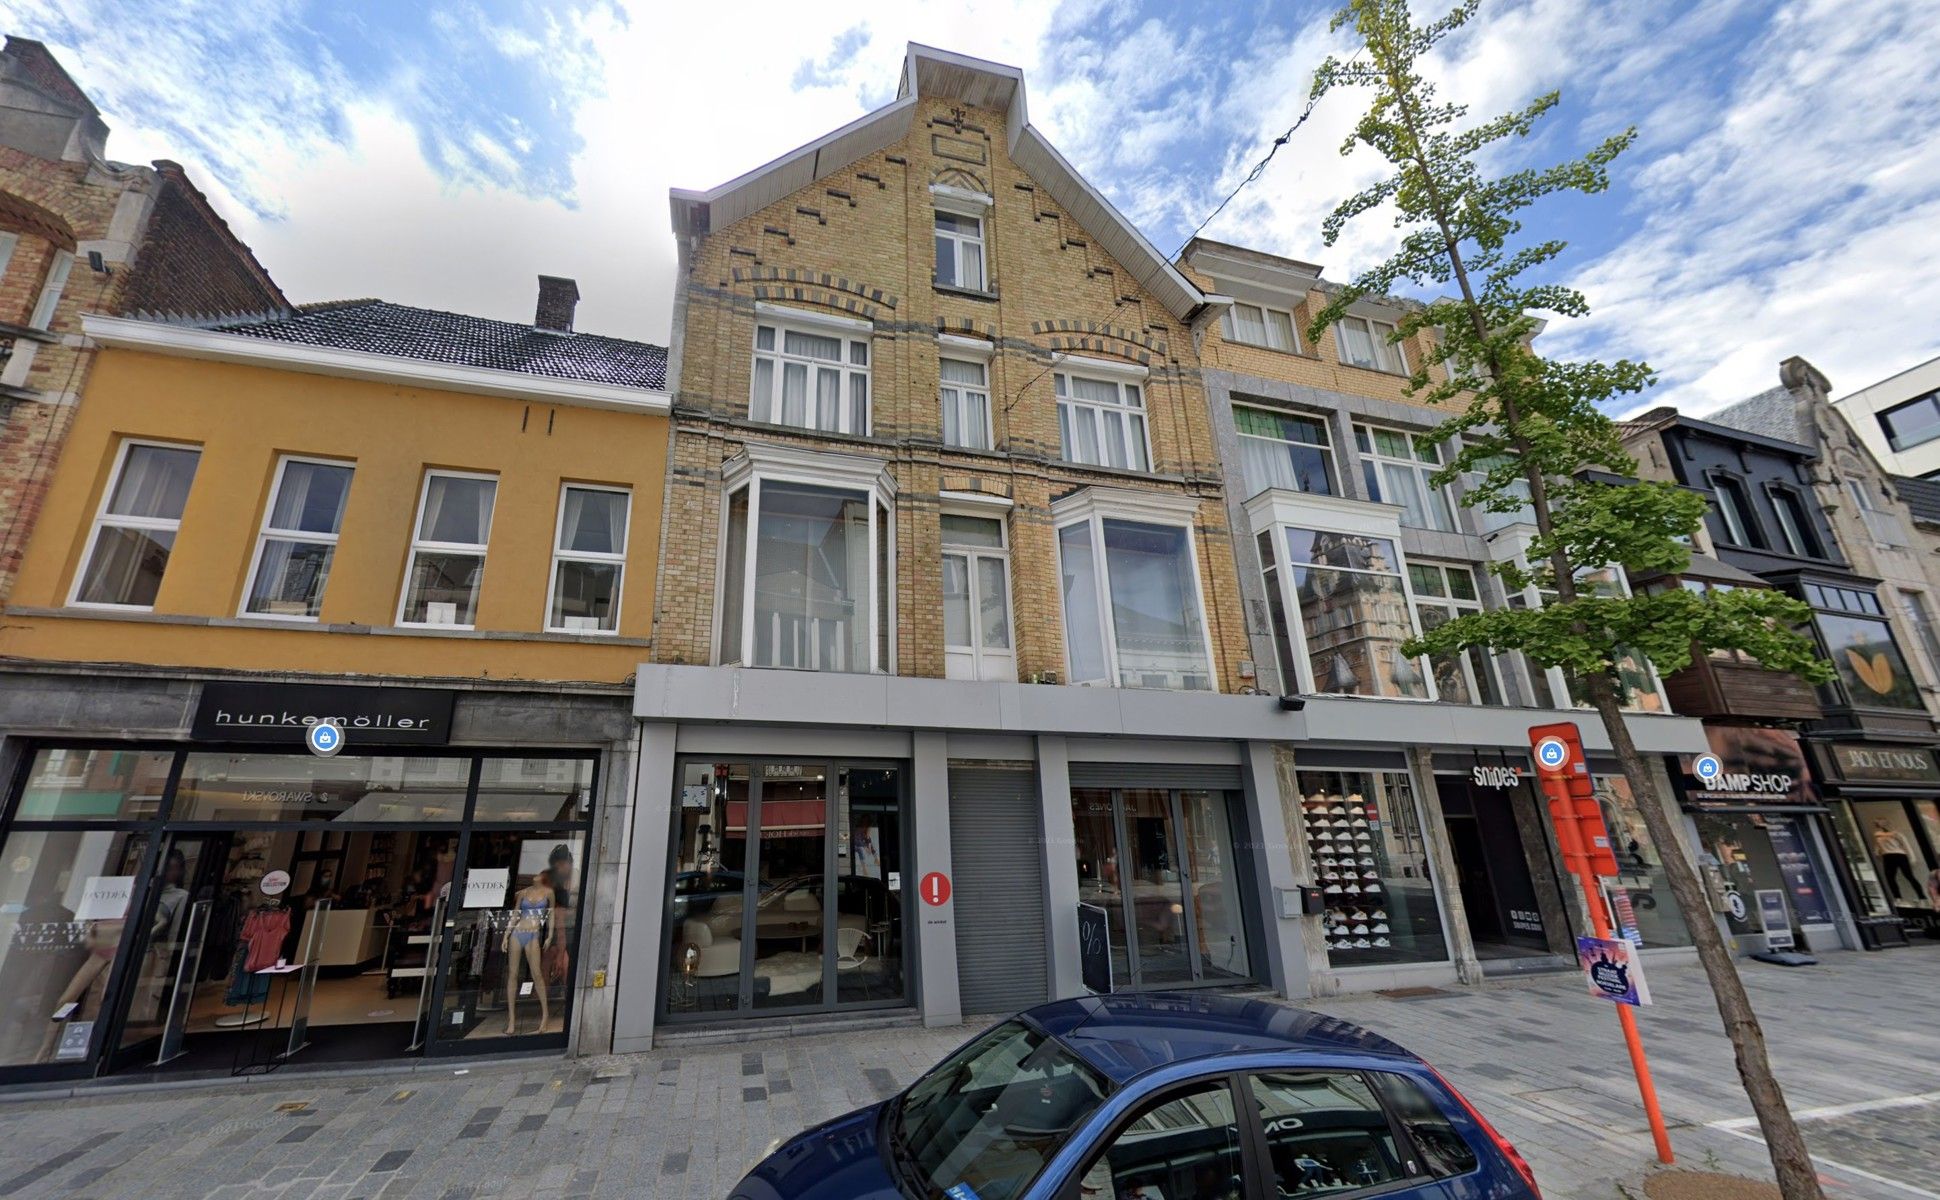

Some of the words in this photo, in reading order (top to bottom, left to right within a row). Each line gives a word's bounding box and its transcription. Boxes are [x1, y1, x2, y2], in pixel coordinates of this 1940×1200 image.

[215, 710, 430, 729] hunkemöller
[1473, 766, 1519, 790] snipes
[1705, 774, 1750, 791] DAMP
[1752, 774, 1791, 792] SHOP
[467, 881, 505, 889] ONTDEK
